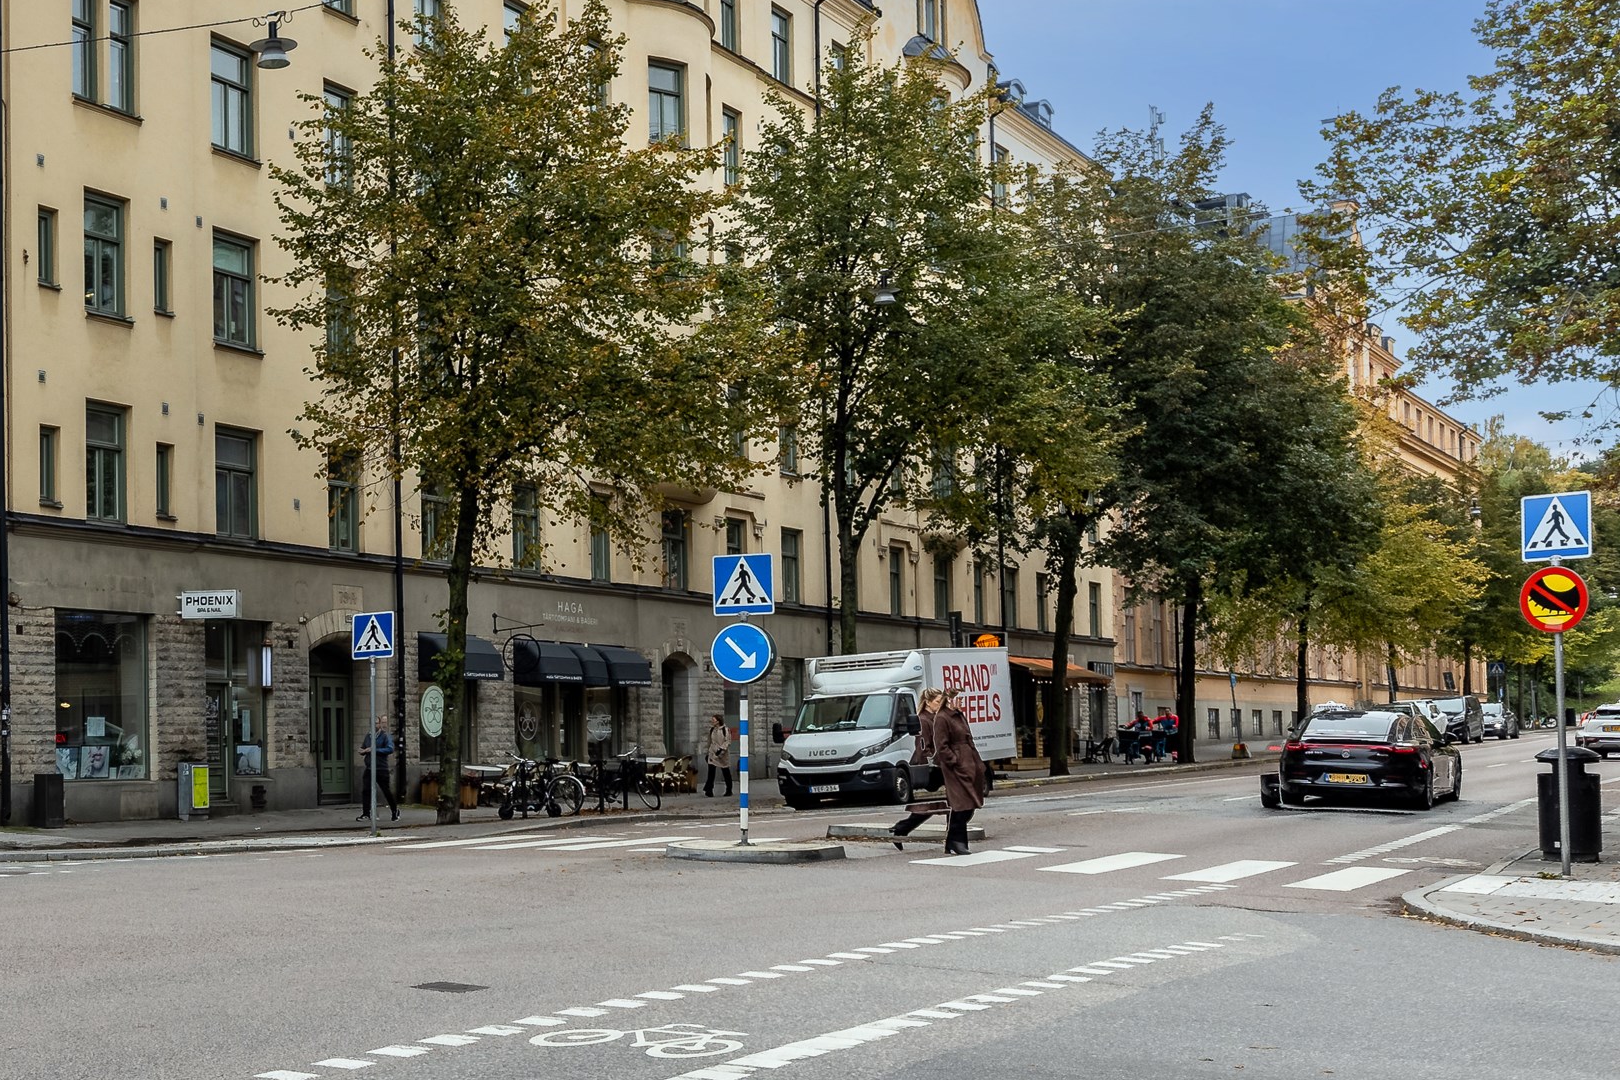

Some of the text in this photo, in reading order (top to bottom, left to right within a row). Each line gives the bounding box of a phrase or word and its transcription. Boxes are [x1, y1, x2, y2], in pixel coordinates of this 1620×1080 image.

[185, 595, 234, 606] PHOENIX
[557, 601, 584, 614] HAGA
[942, 664, 991, 693] BRAND
[954, 693, 1002, 723] HEELS
[808, 749, 838, 757] IVECO
